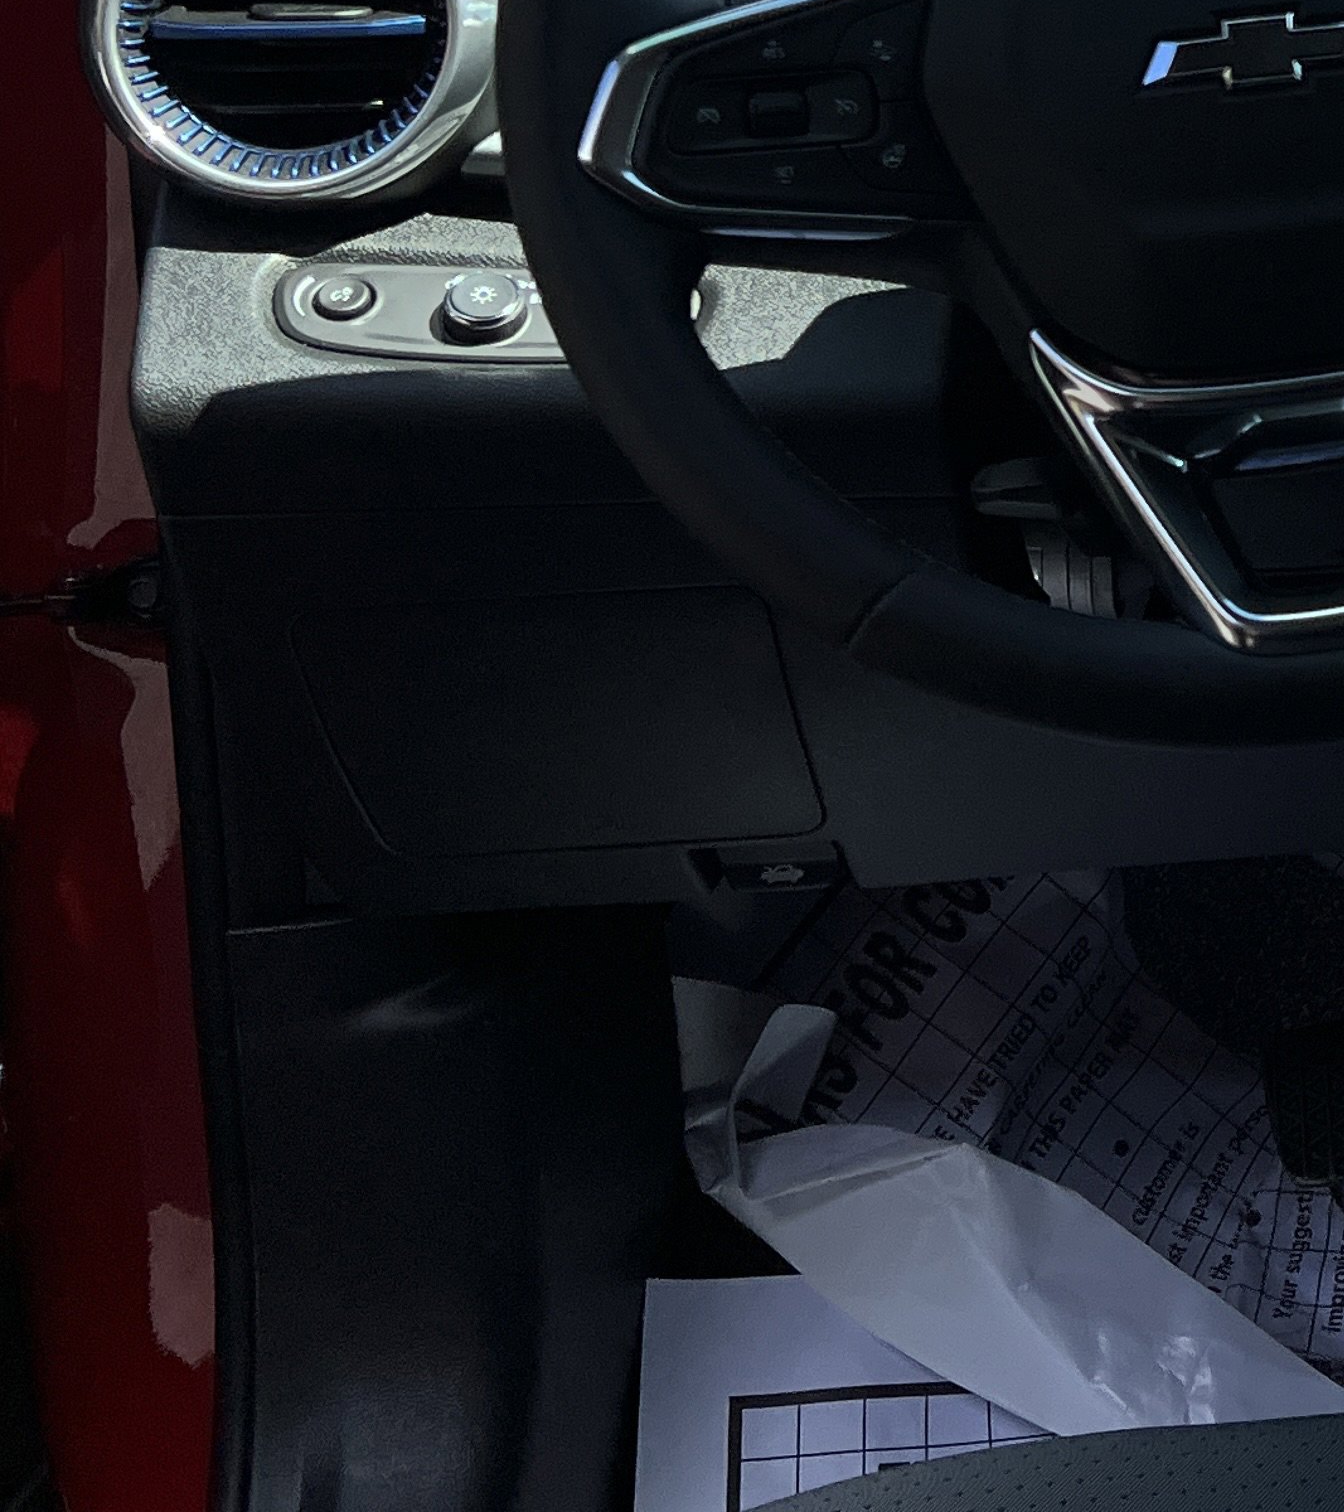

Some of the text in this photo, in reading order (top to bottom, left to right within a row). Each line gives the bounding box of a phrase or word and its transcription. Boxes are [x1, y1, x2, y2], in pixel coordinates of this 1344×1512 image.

[825, 931, 938, 1051] FOR
[947, 1066, 999, 1126] HAVE
[988, 1013, 1039, 1070] TRIED
[1030, 985, 1060, 1014] TO
[1051, 935, 1091, 982] KEEP
[1029, 1106, 1067, 1160] THIS
[1059, 1052, 1113, 1115] PAPER
[1132, 1120, 1201, 1226] customer is
[1181, 1150, 1234, 1243] important
[1228, 1104, 1270, 1156] perso
[1208, 1253, 1235, 1282] the
[1272, 1190, 1314, 1320] Your suggest
